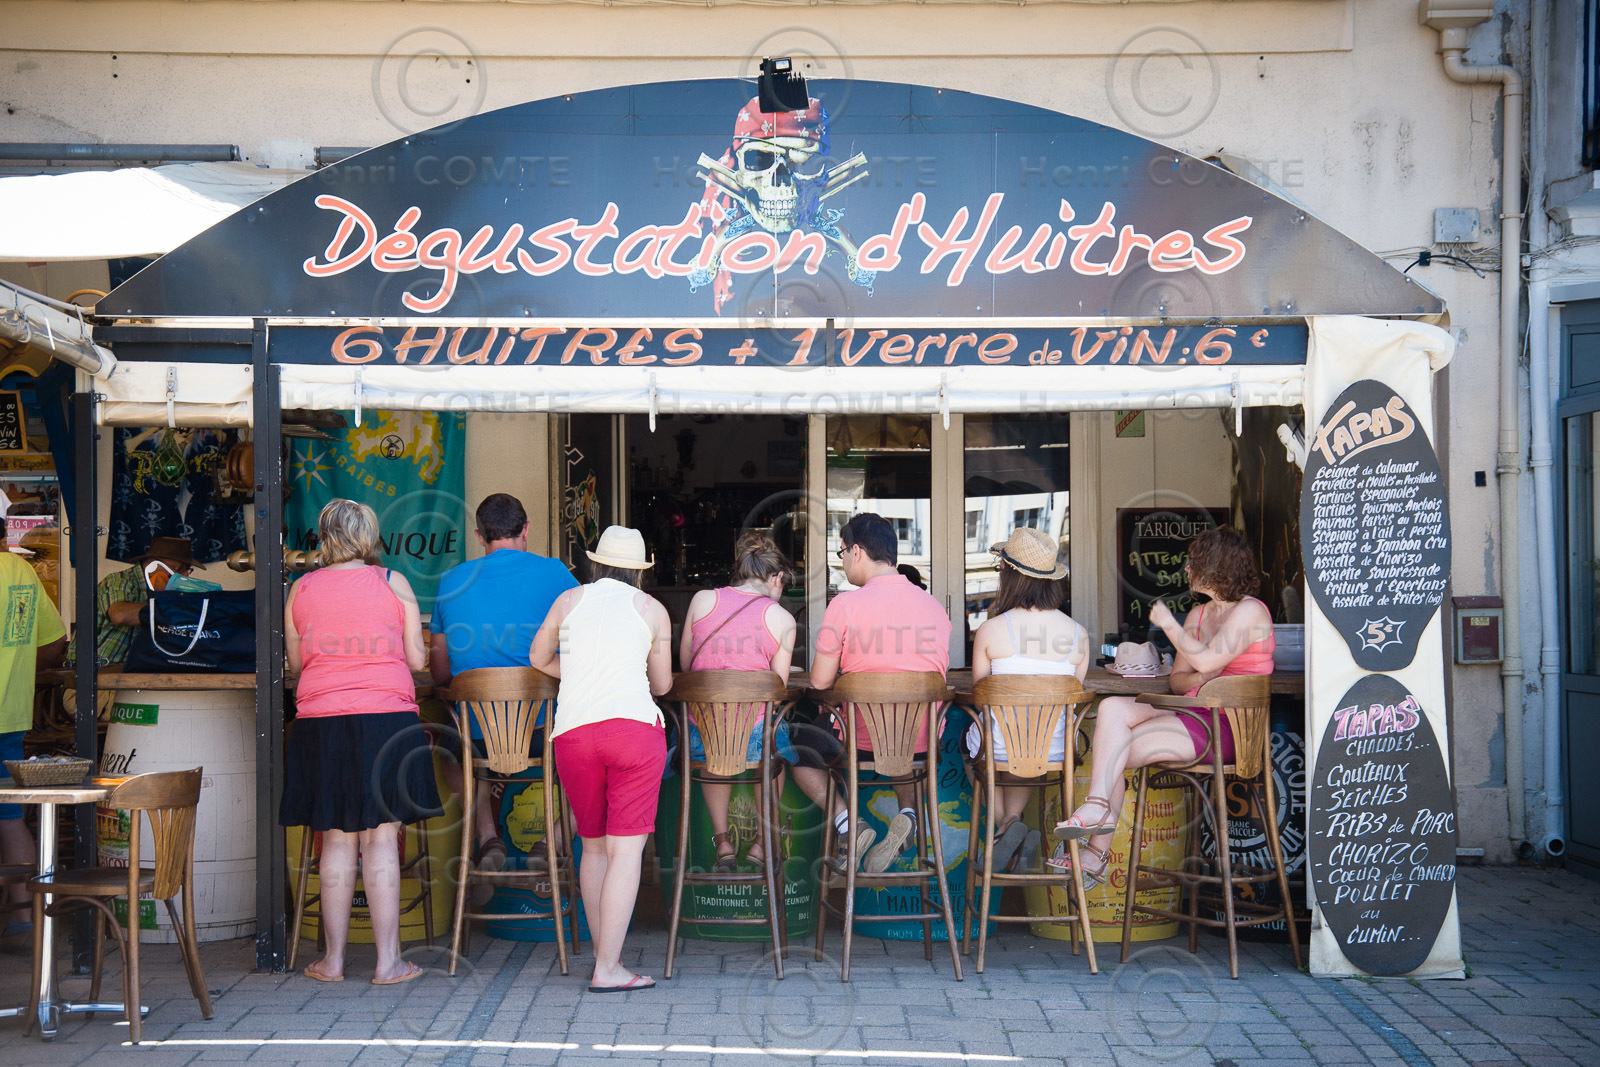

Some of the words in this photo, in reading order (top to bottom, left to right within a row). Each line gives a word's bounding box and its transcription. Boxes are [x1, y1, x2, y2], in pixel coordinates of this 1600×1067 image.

[303, 194, 827, 313] Dégustation
[855, 192, 1253, 287] d'Huitres
[1028, 338, 1062, 366] de
[1312, 396, 1415, 465] TAPAS
[1315, 464, 1361, 479] Beignet
[1362, 466, 1373, 475] de
[1311, 478, 1357, 491] Crevettes
[1357, 480, 1366, 488] et
[1365, 474, 1397, 488] Moules
[1404, 472, 1437, 485] Persillade
[1313, 490, 1355, 504] Tartines
[1361, 485, 1420, 502] Espagnoles
[1405, 497, 1443, 511] Anchois
[1135, 521, 1211, 540] TARIQUET
[1312, 516, 1358, 530] Poivrons
[1397, 516, 1410, 524] au
[1362, 530, 1369, 540] à
[1371, 525, 1394, 539] l'ail
[1396, 527, 1406, 537] et
[1313, 541, 1357, 555] Assiette
[1360, 542, 1372, 553] de
[1370, 538, 1422, 554] Jambon
[1313, 554, 1356, 569] Assiette
[1360, 555, 1372, 566] de
[1375, 552, 1422, 567] Chorizo
[1318, 567, 1361, 582] Assiette
[1366, 563, 1441, 580] Soubressade
[1332, 594, 1374, 608] Assiette
[1376, 595, 1390, 606] de
[1425, 591, 1444, 607] (big)
[1333, 695, 1421, 741] TAPAS
[1387, 816, 1405, 834] de
[1410, 808, 1456, 836] PORC
[1386, 866, 1403, 882] de
[1409, 864, 1456, 882] CANARD
[717, 884, 752, 896] RHUM
[1334, 879, 1420, 904] POULET
[696, 895, 750, 908] TRADITIONNEL
[755, 899, 764, 907] DE
[1361, 908, 1381, 919] au
